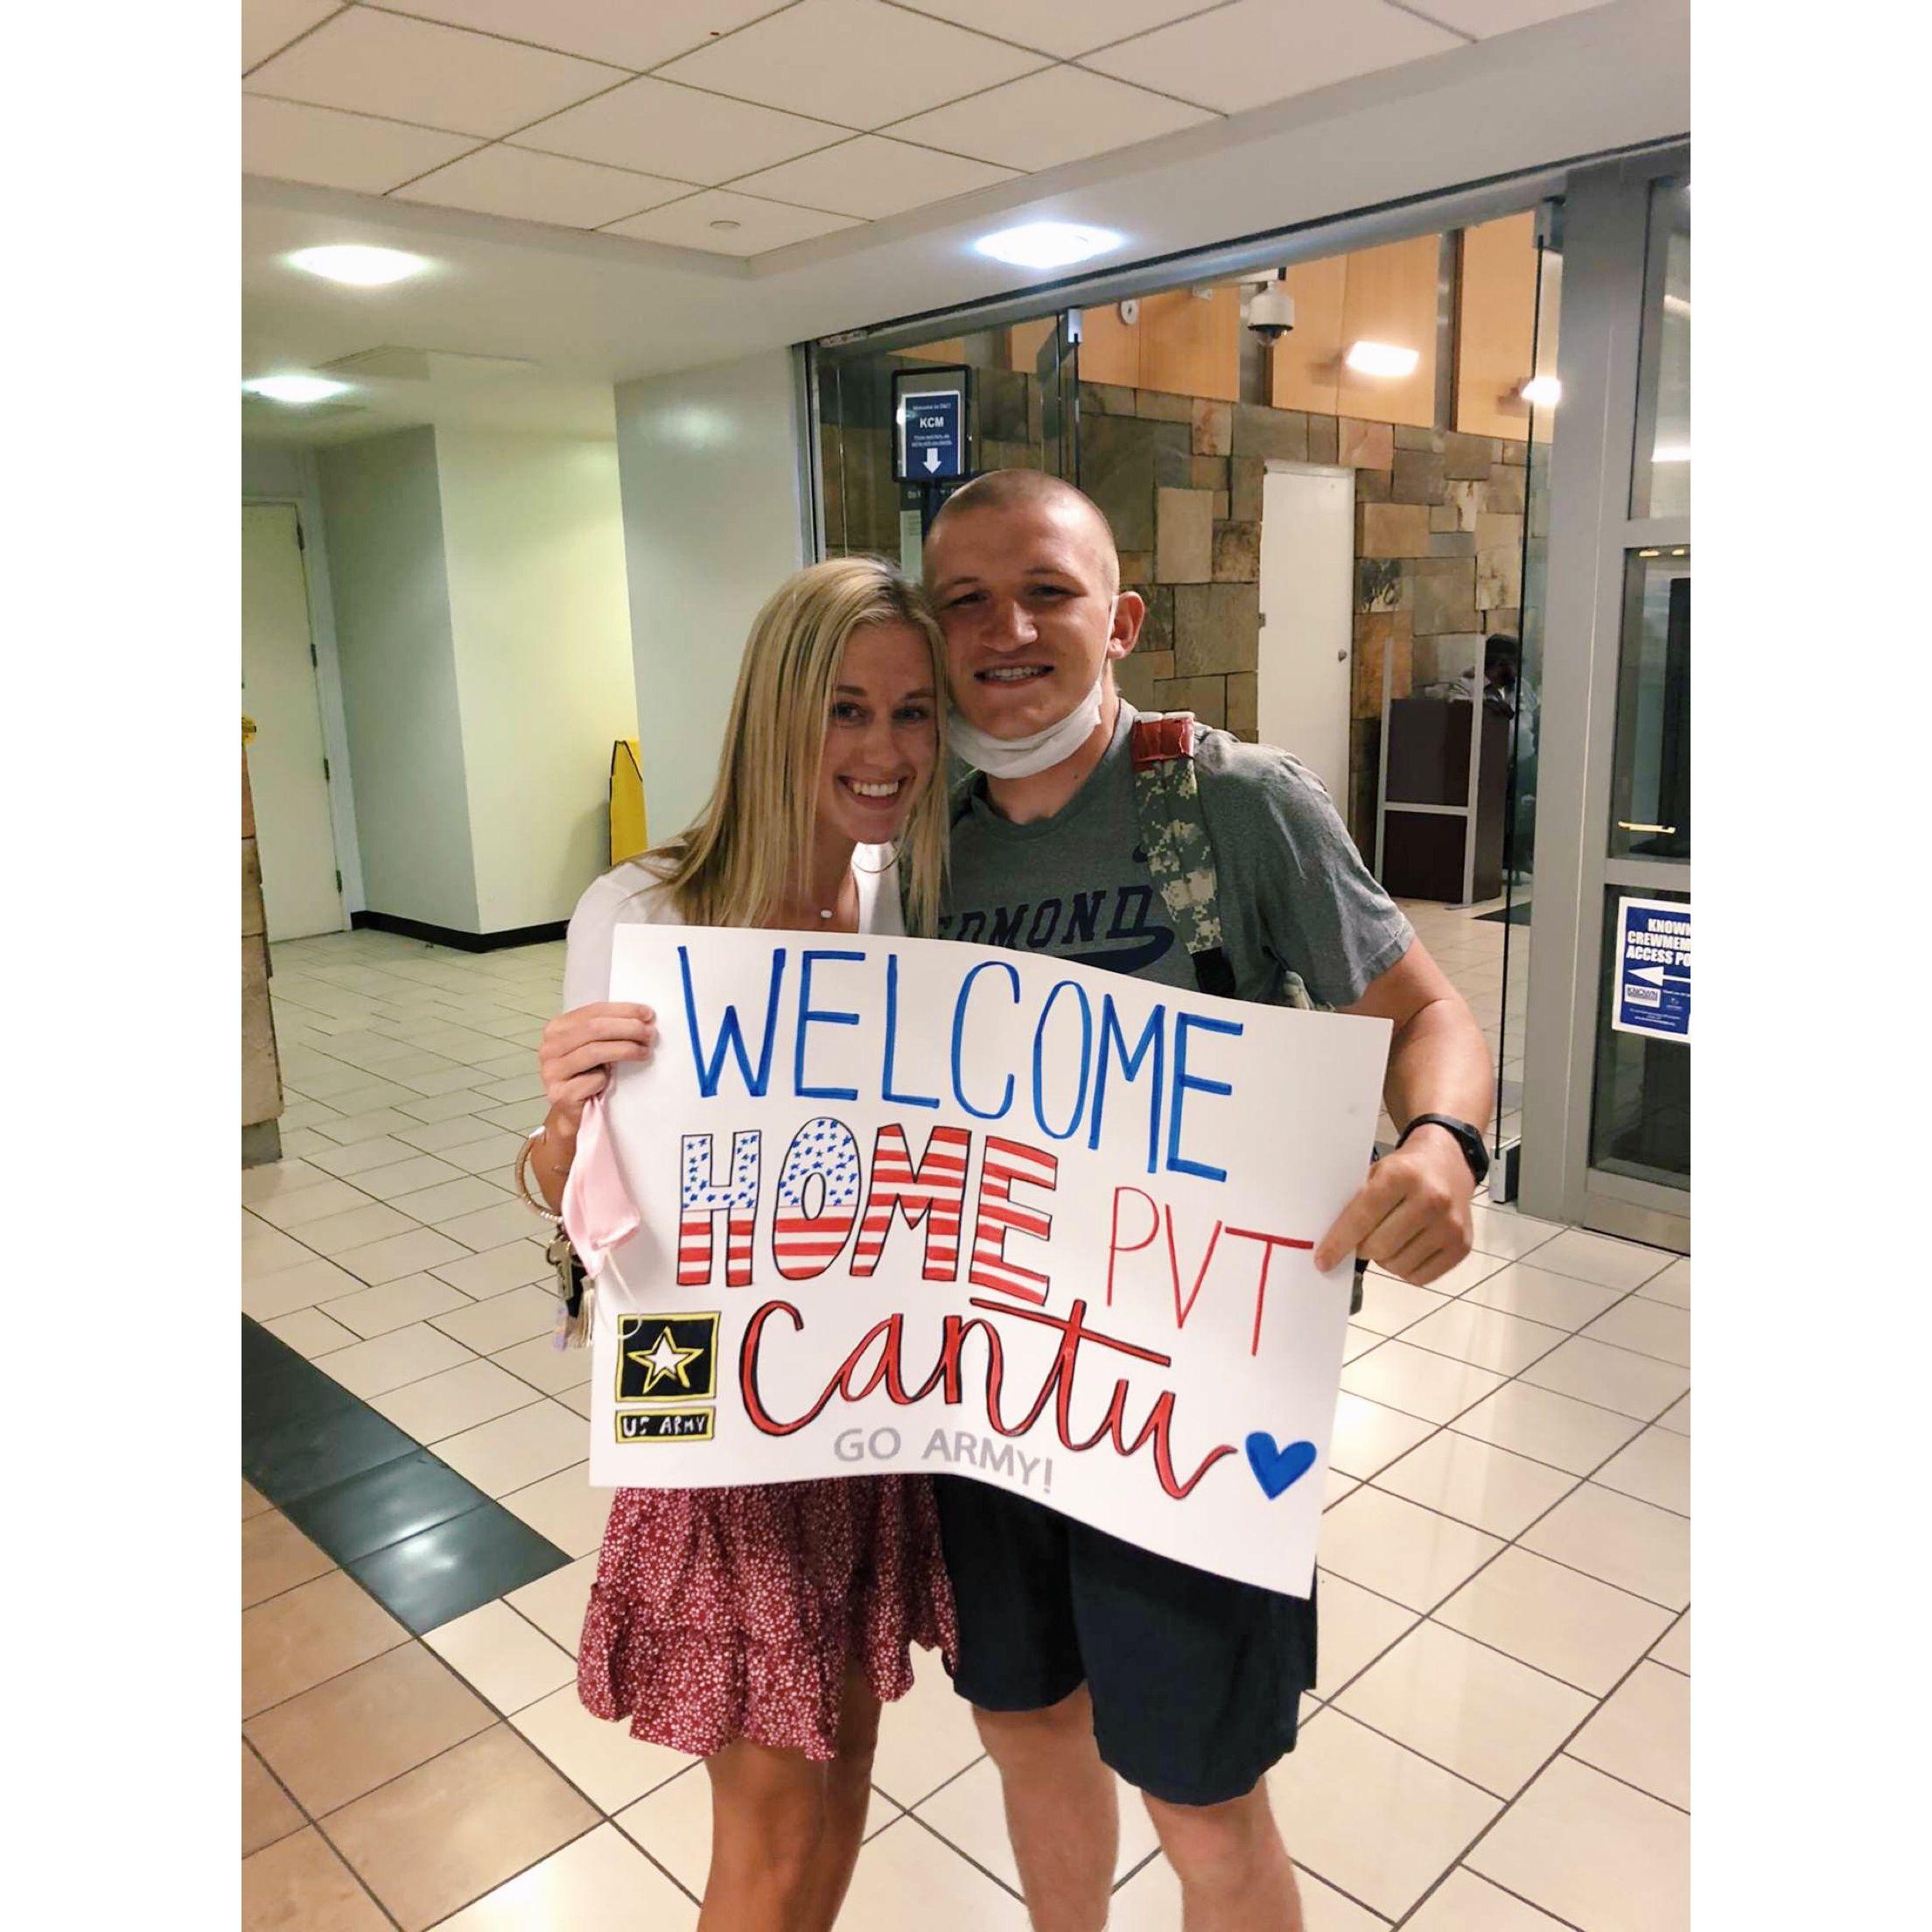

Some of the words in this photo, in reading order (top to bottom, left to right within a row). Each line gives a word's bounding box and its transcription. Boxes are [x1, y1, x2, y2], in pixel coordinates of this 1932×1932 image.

[920, 416, 944, 428] KCM
[1626, 945, 1674, 964] ACCESS
[677, 946, 1243, 1182] WELCOME
[676, 1116, 1059, 1306] HOME
[1107, 1186, 1315, 1356] PVT
[623, 1417, 649, 1437] US
[659, 1415, 705, 1435] ARMY
[738, 1298, 1238, 1500] Cantu
[834, 1427, 901, 1462] GO
[921, 1428, 1053, 1494] ARMY!
